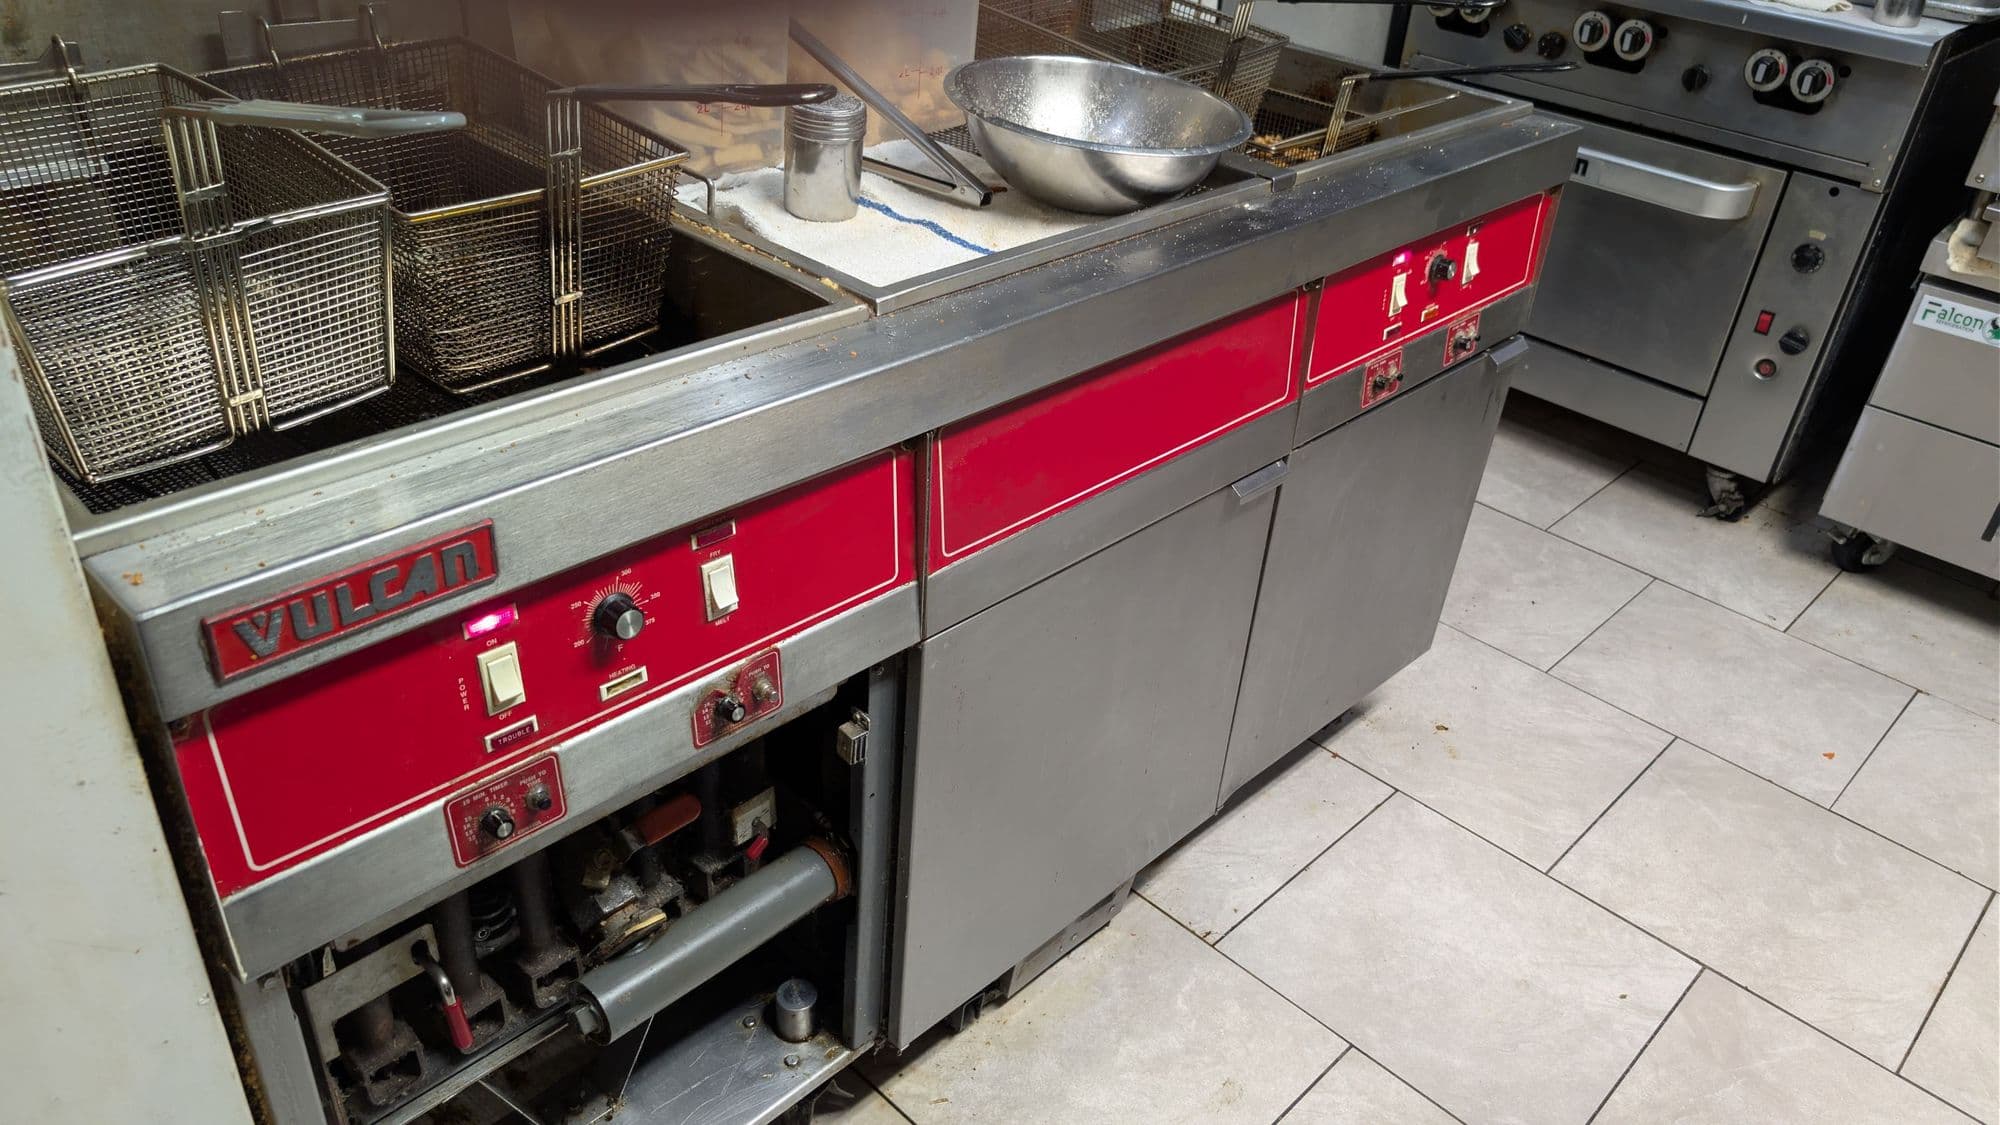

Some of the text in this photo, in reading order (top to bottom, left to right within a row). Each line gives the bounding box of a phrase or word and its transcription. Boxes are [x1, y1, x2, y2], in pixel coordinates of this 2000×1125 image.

[1921, 301, 1985, 331] Falcon
[232, 540, 481, 657] VULCAN
[486, 637, 497, 647] ON
[608, 663, 636, 679] HEATING
[458, 677, 470, 712] POWER
[499, 710, 512, 721] OFF
[498, 726, 530, 745] TROUBLE
